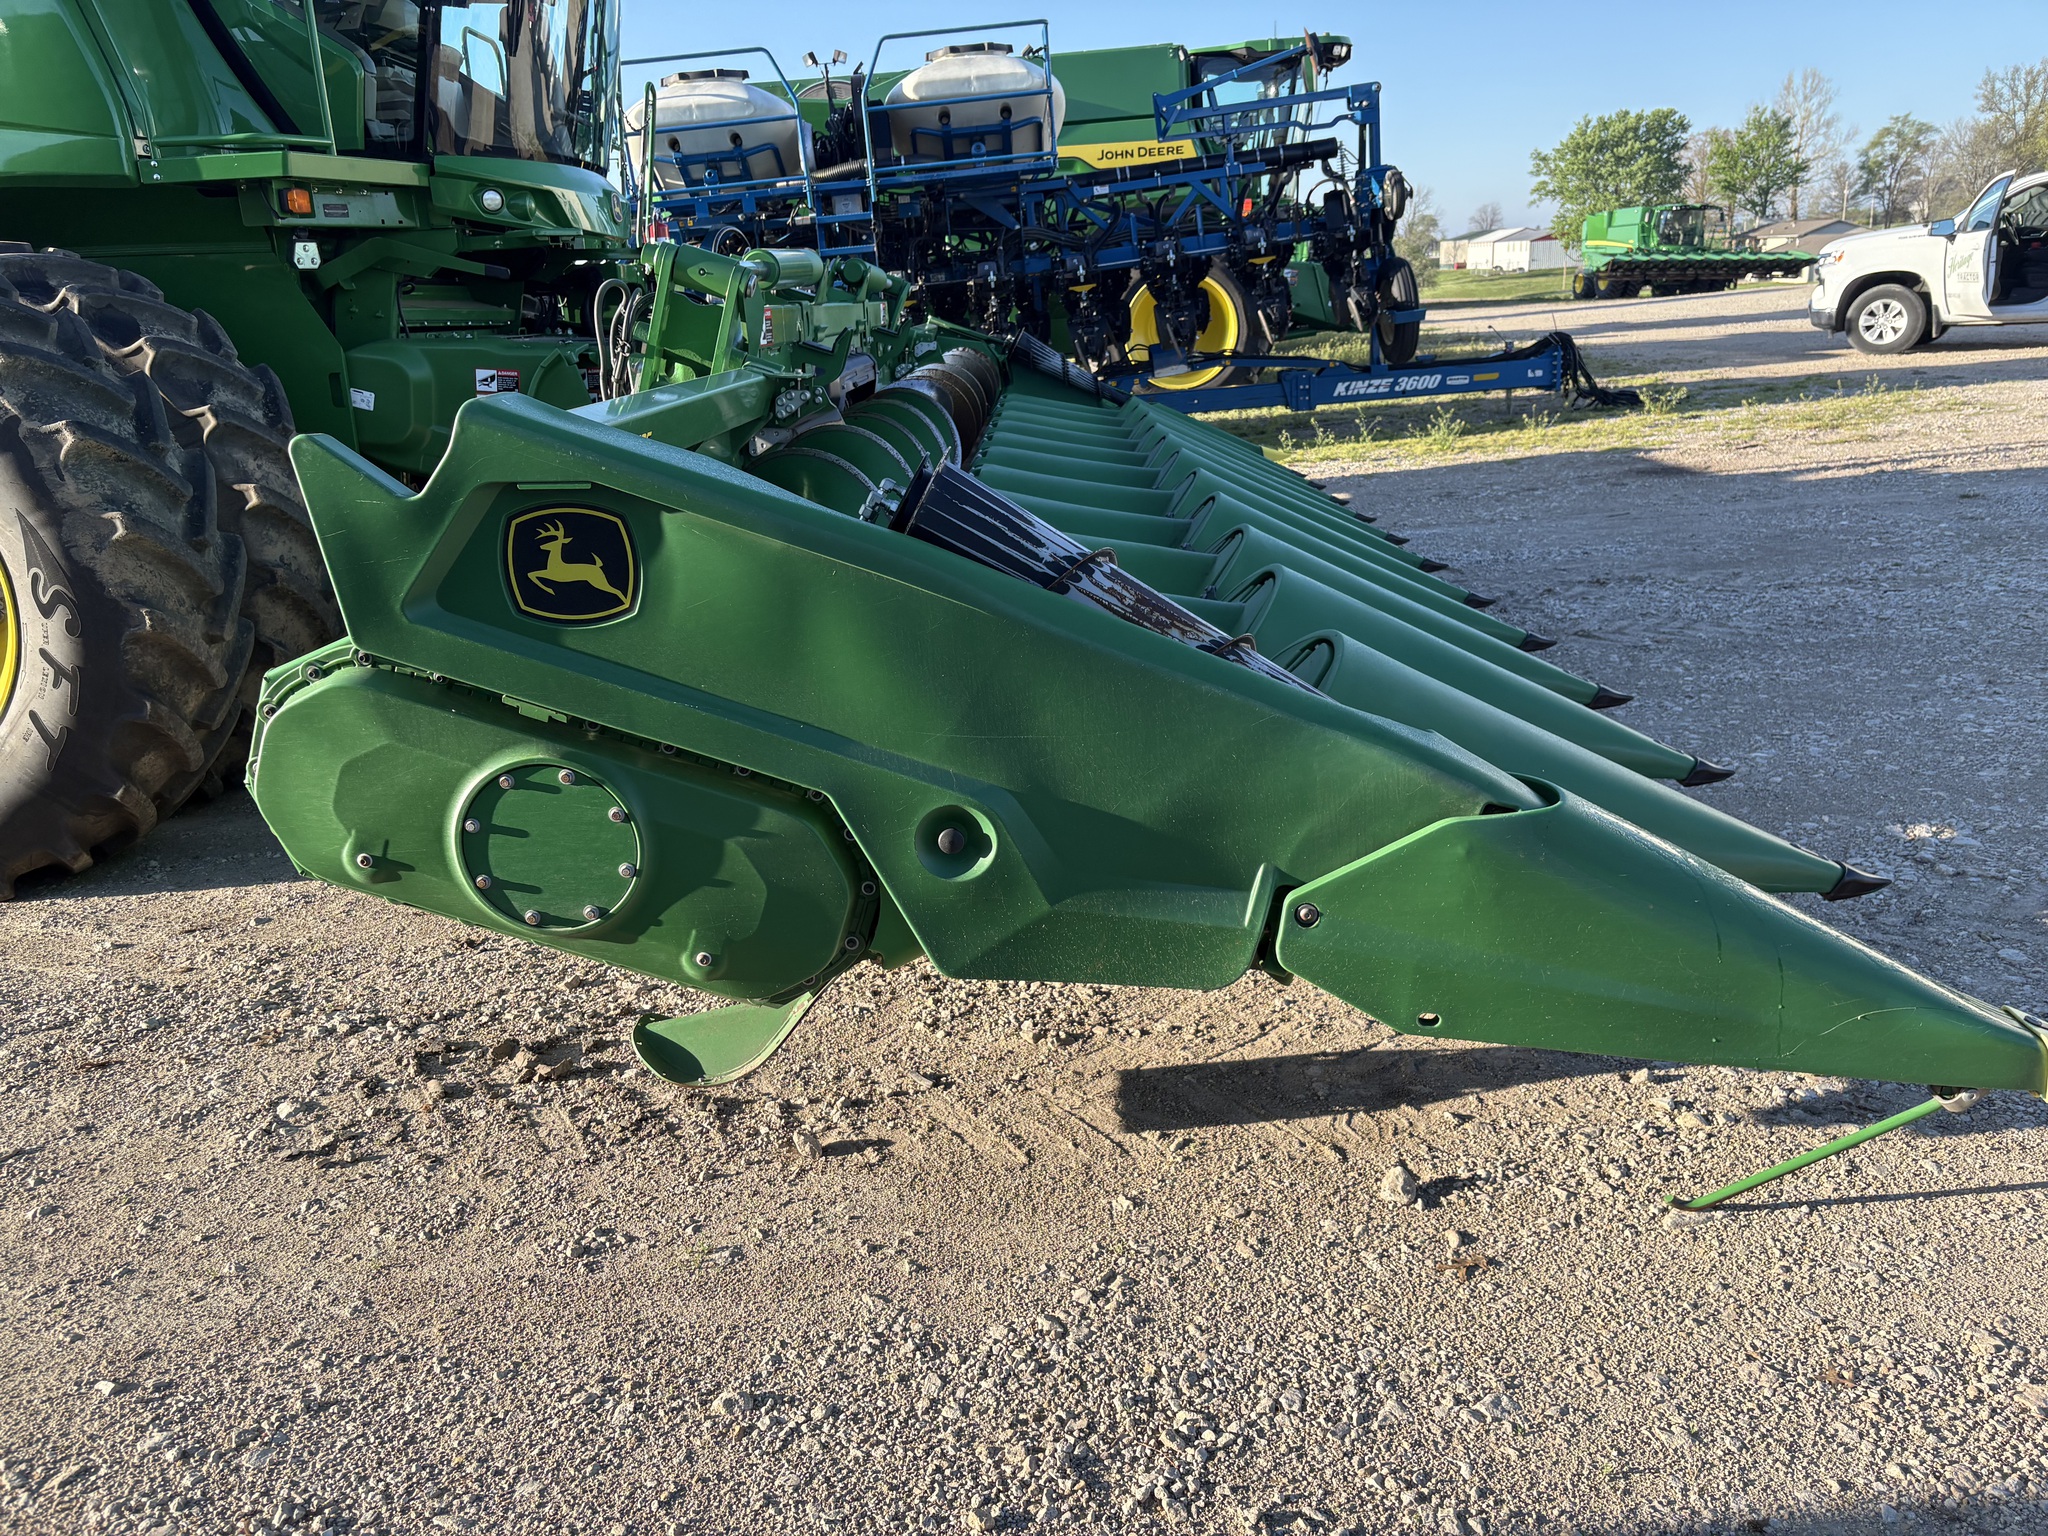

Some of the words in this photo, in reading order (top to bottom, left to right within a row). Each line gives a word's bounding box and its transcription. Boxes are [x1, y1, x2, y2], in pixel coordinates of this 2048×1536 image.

[1097, 149, 1134, 161] JOHN
[1138, 145, 1184, 158] DEERE
[1957, 273, 1979, 281] TRACTOR
[1333, 378, 1393, 397] KINZE
[1394, 374, 1442, 392] 3600
